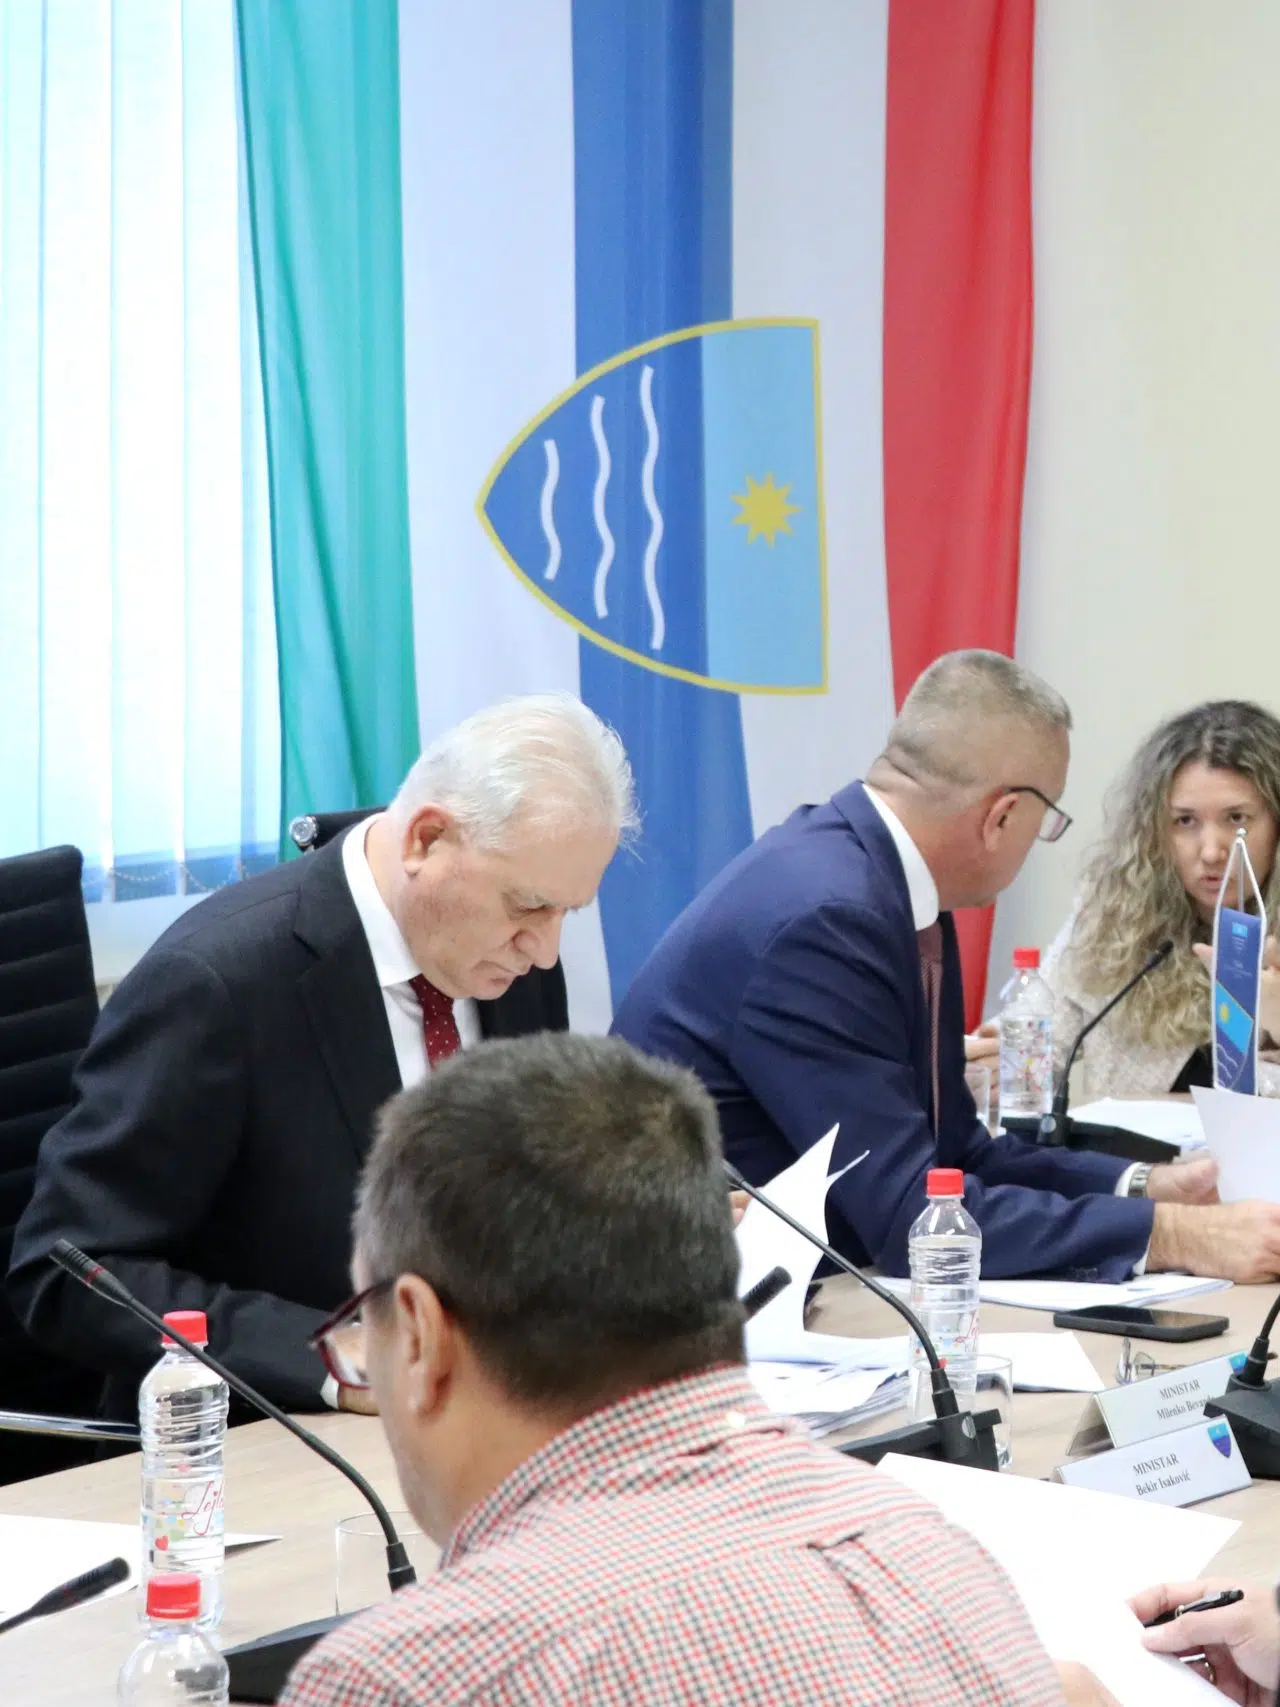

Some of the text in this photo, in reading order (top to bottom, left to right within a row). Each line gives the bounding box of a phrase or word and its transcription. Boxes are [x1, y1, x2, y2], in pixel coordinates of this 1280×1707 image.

[1159, 1379, 1201, 1399] MINISTAR
[1156, 1401, 1185, 1420] Milenko
[1132, 1454, 1179, 1476] MINISTAR
[1135, 1471, 1191, 1496] Bekir Isaković
